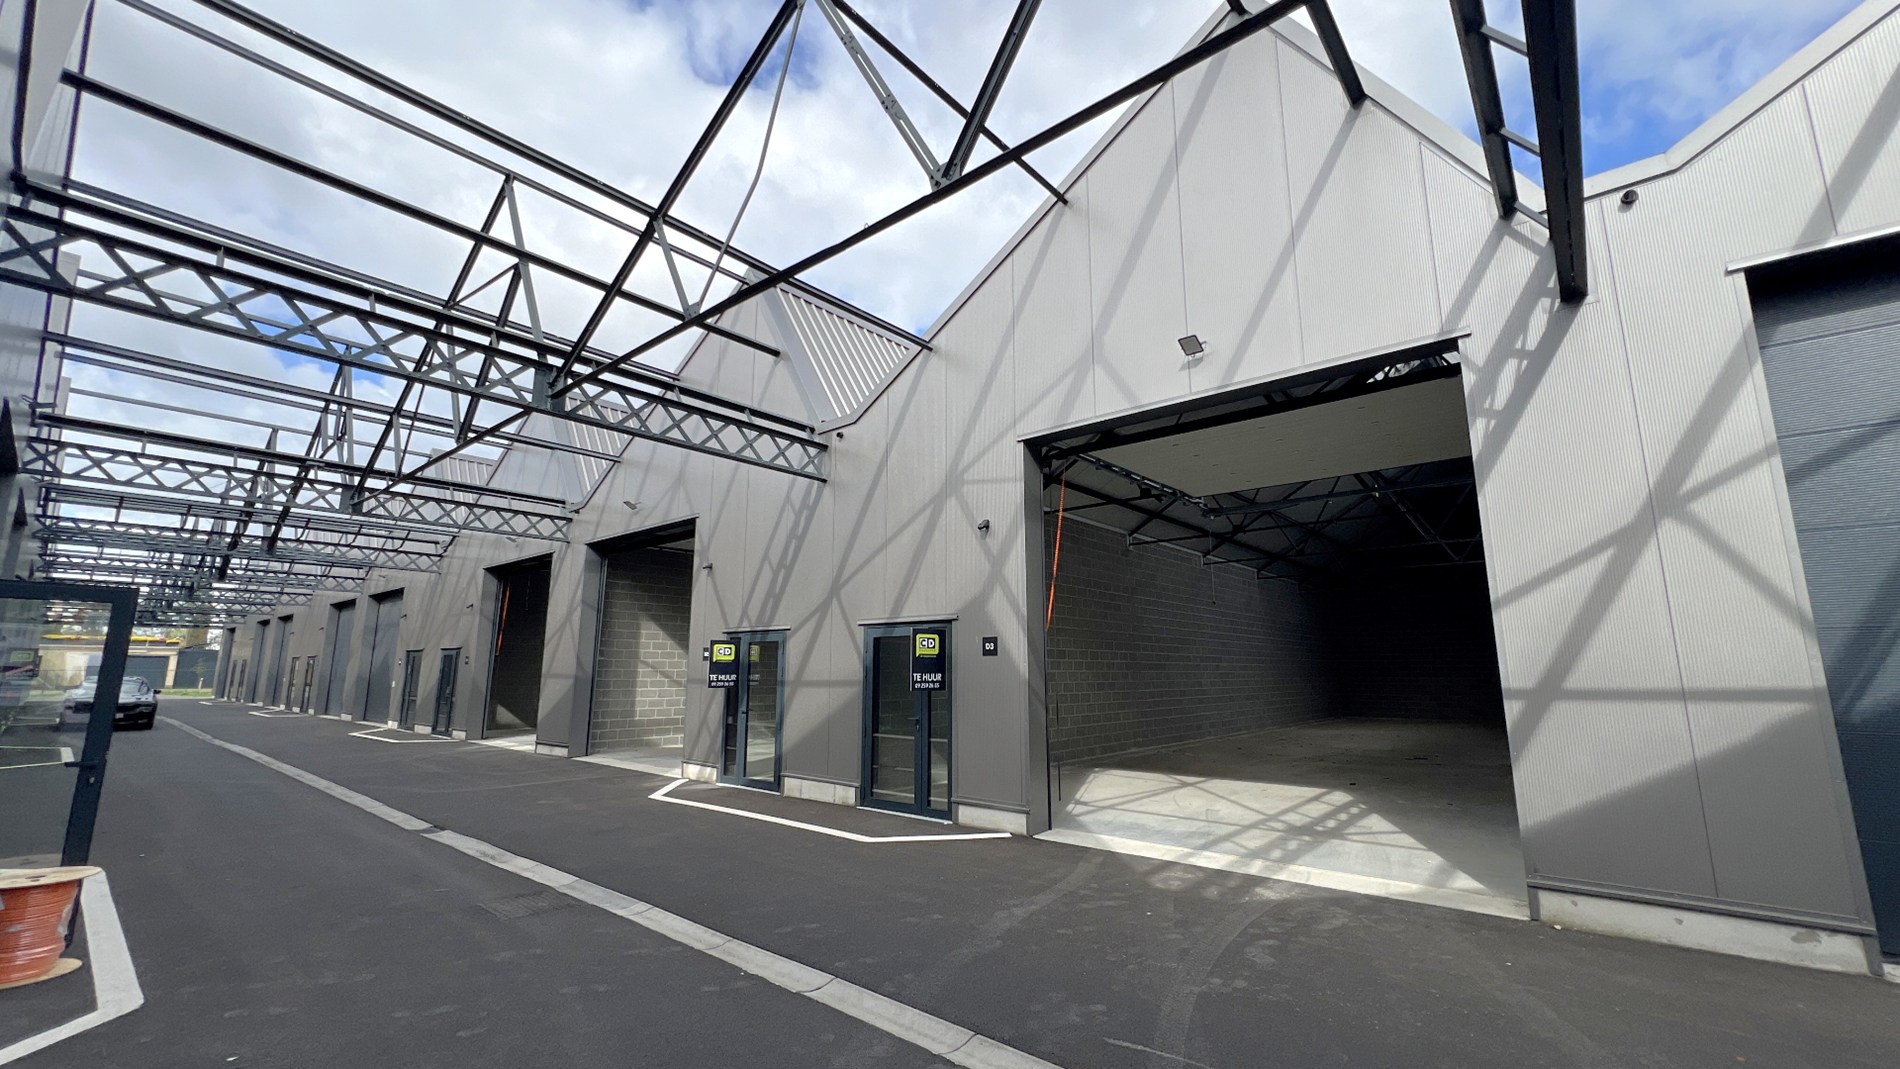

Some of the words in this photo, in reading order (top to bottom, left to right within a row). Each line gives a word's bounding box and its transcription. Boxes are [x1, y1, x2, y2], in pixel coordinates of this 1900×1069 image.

[920, 638, 935, 648] CD
[913, 673, 922, 681] TE
[922, 673, 942, 681] HUUR
